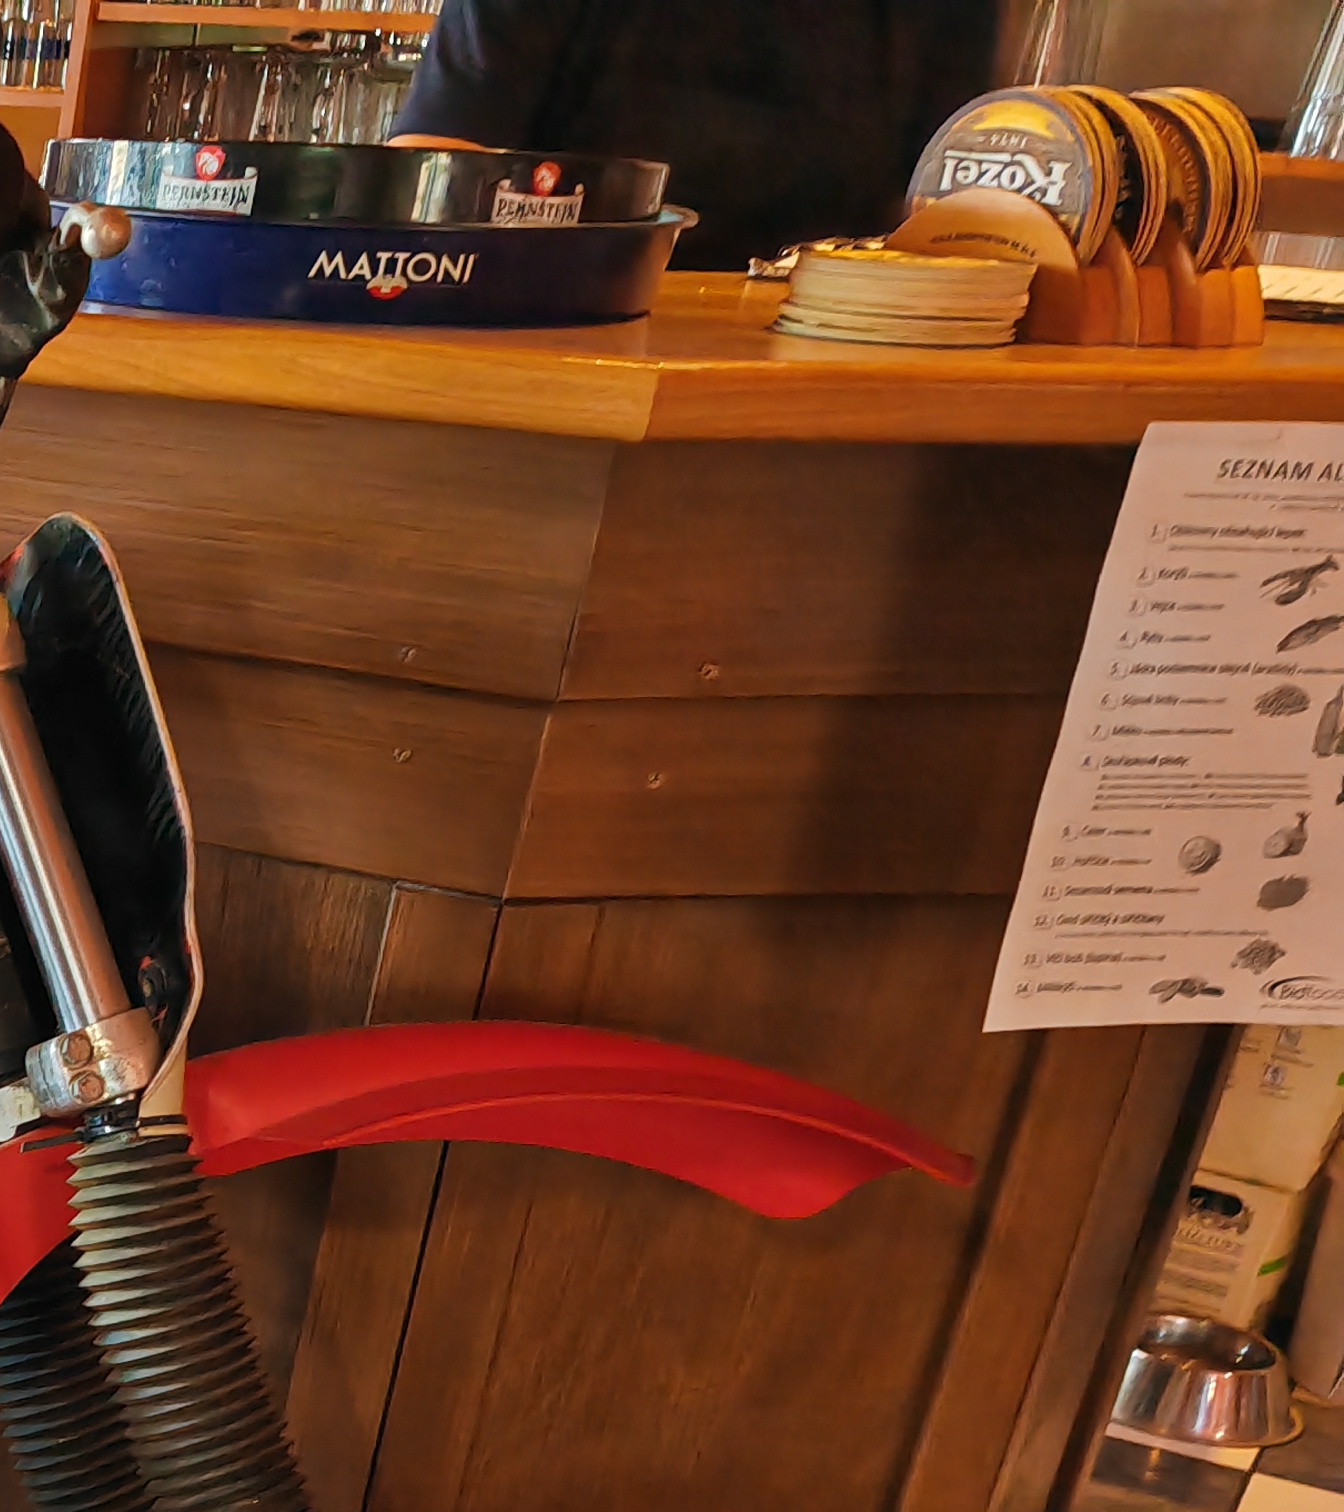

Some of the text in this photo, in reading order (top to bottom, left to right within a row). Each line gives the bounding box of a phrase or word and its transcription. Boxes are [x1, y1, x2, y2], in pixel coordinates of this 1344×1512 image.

[939, 149, 1073, 206] Kozel
[307, 250, 476, 285] MATTONI
[1216, 458, 1314, 482] SEZNAM
